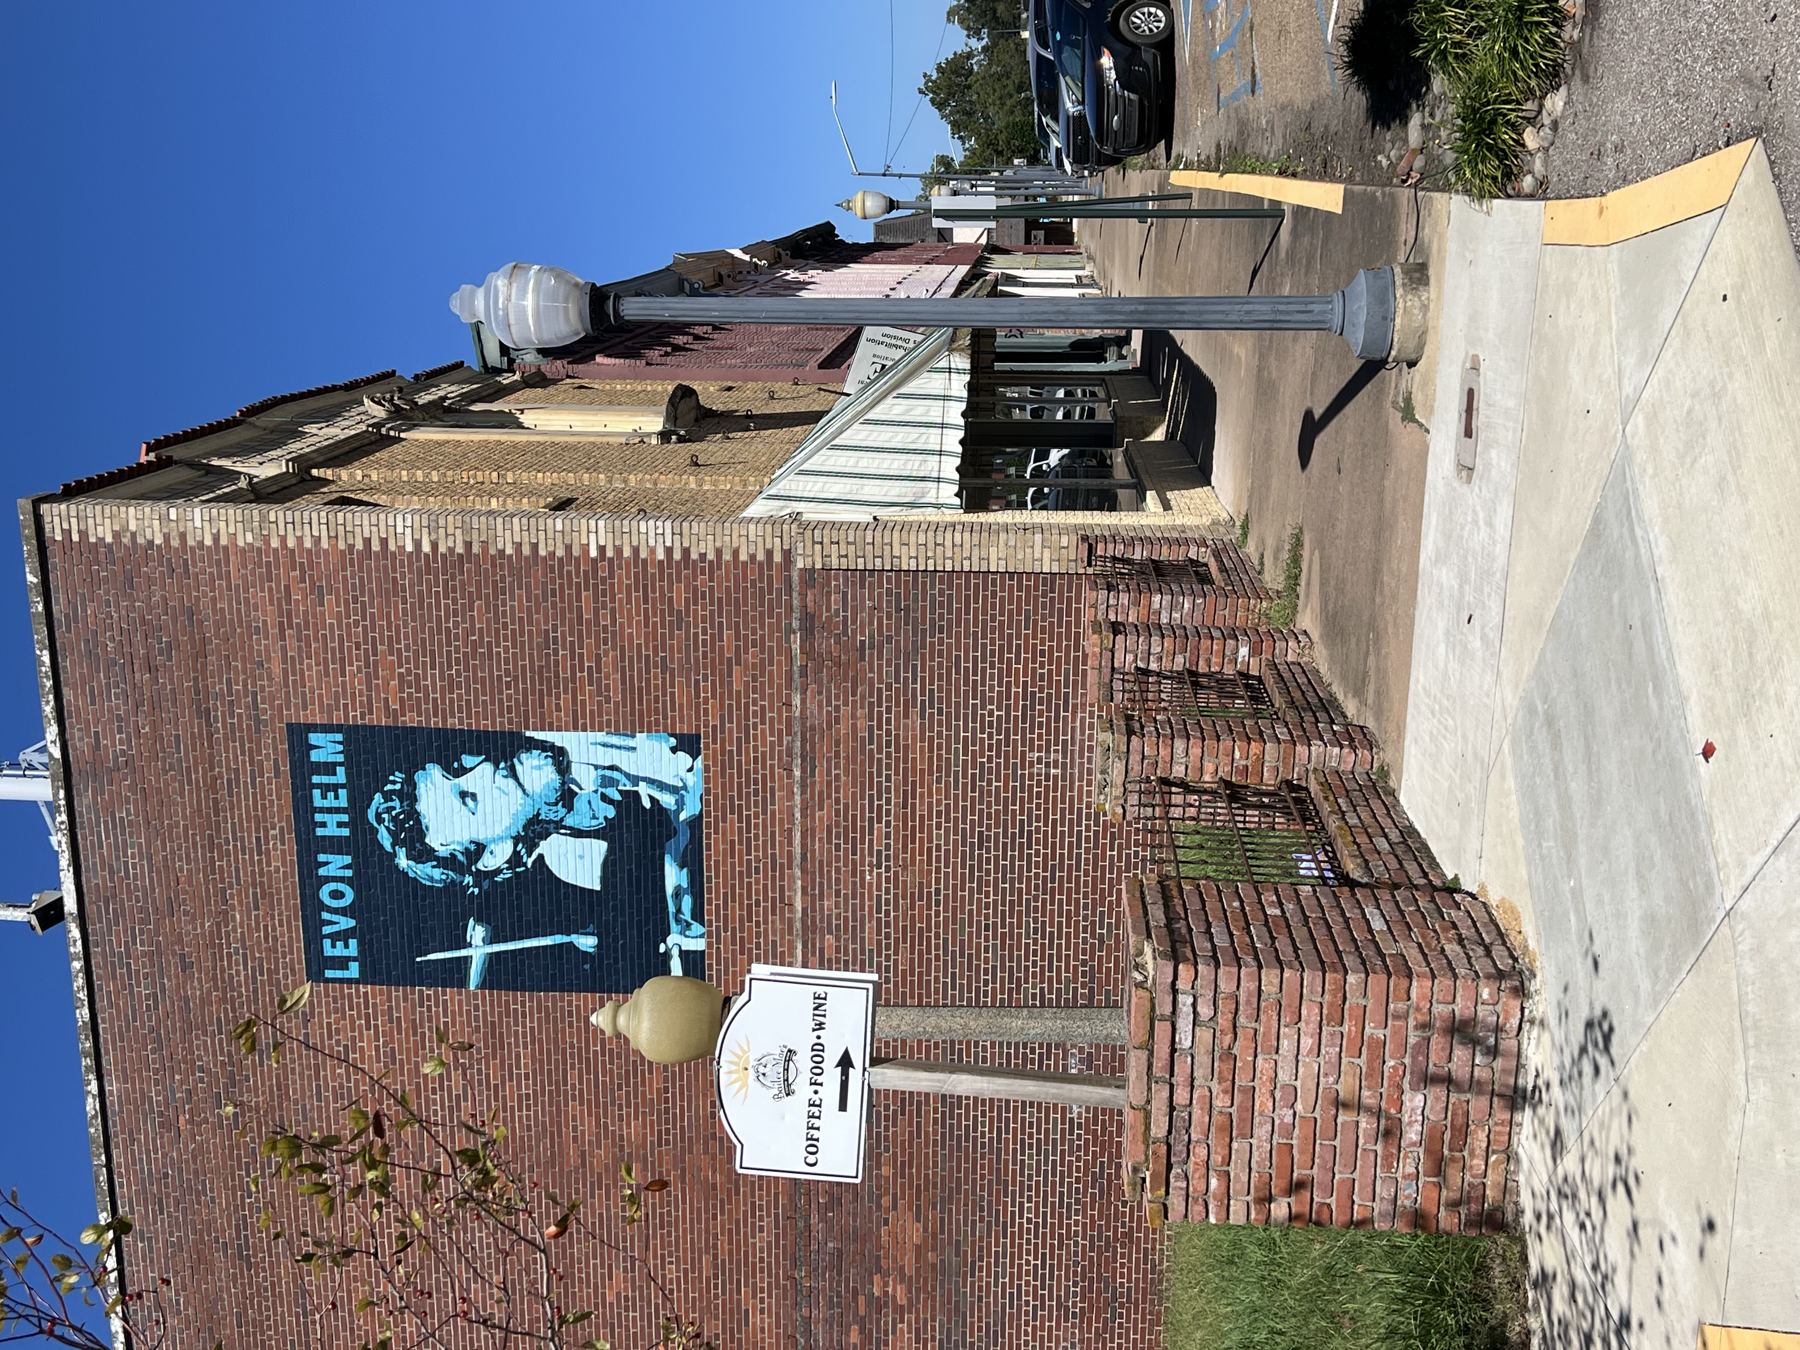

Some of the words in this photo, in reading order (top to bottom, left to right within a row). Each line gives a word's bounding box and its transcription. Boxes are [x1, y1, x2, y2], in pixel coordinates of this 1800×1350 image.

[881, 332, 911, 345] Division
[308, 732, 350, 836] HELM
[317, 853, 360, 979] LEVON
[811, 991, 828, 1033] WINE
[769, 1071, 785, 1102] Bailee
[809, 1042, 826, 1088] FOOD
[804, 1096, 824, 1168] COFFEE
